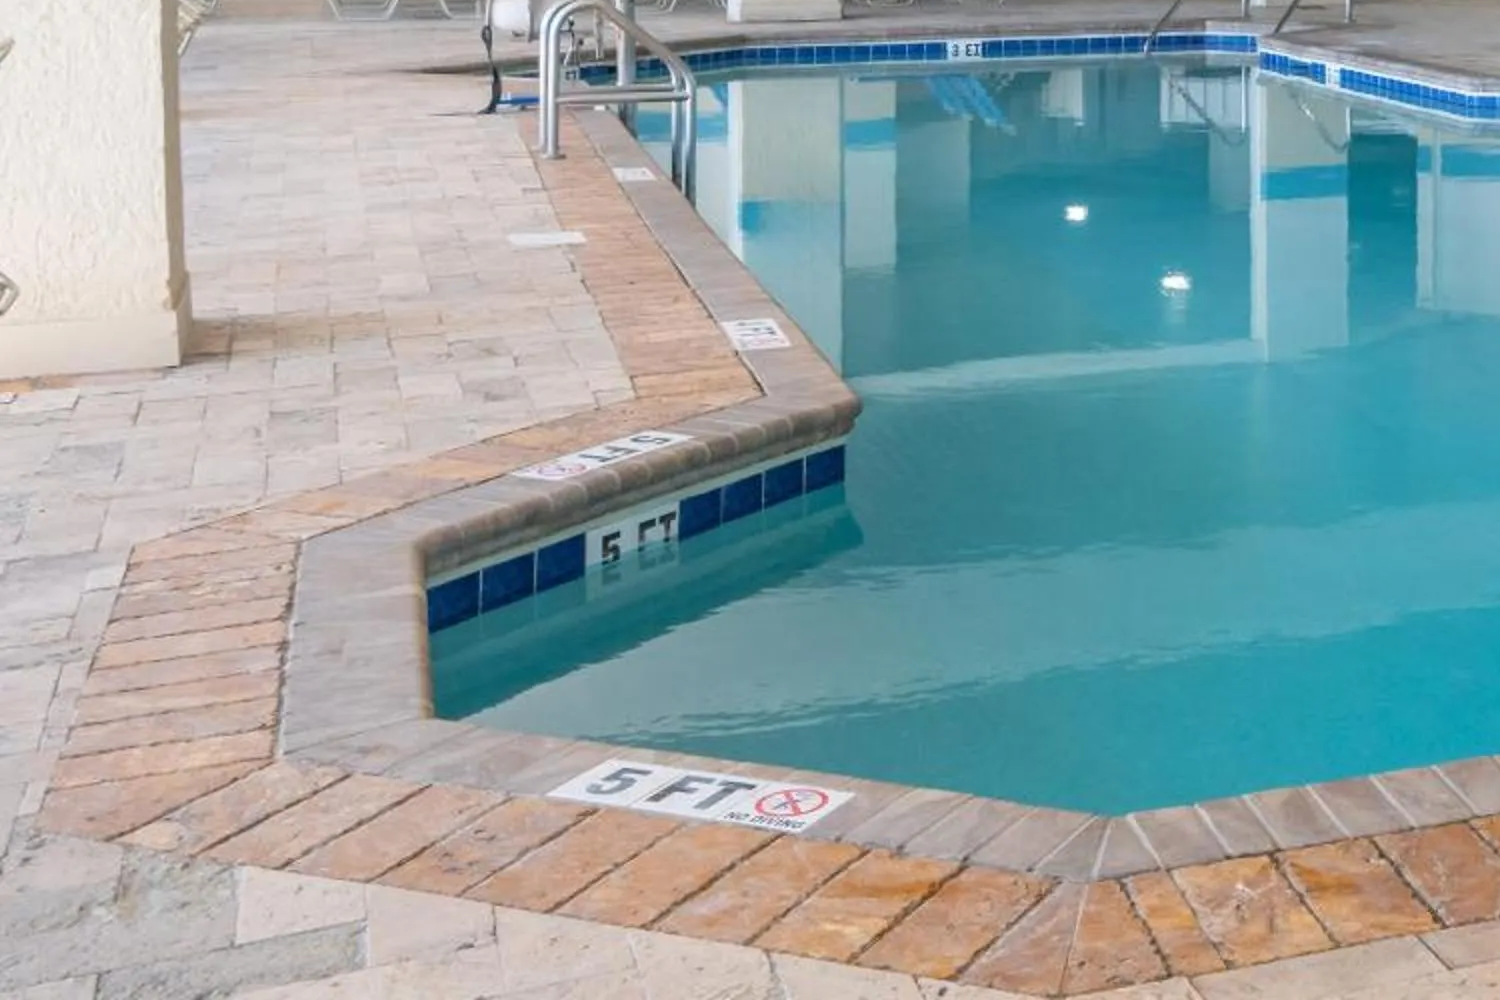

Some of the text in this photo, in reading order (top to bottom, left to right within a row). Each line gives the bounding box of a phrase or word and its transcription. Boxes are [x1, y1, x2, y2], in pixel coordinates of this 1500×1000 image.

[578, 435, 672, 462] 5 FT
[602, 510, 677, 566] 5 FT
[586, 767, 756, 810] 5 FT
[724, 811, 805, 829] NO DIVING
